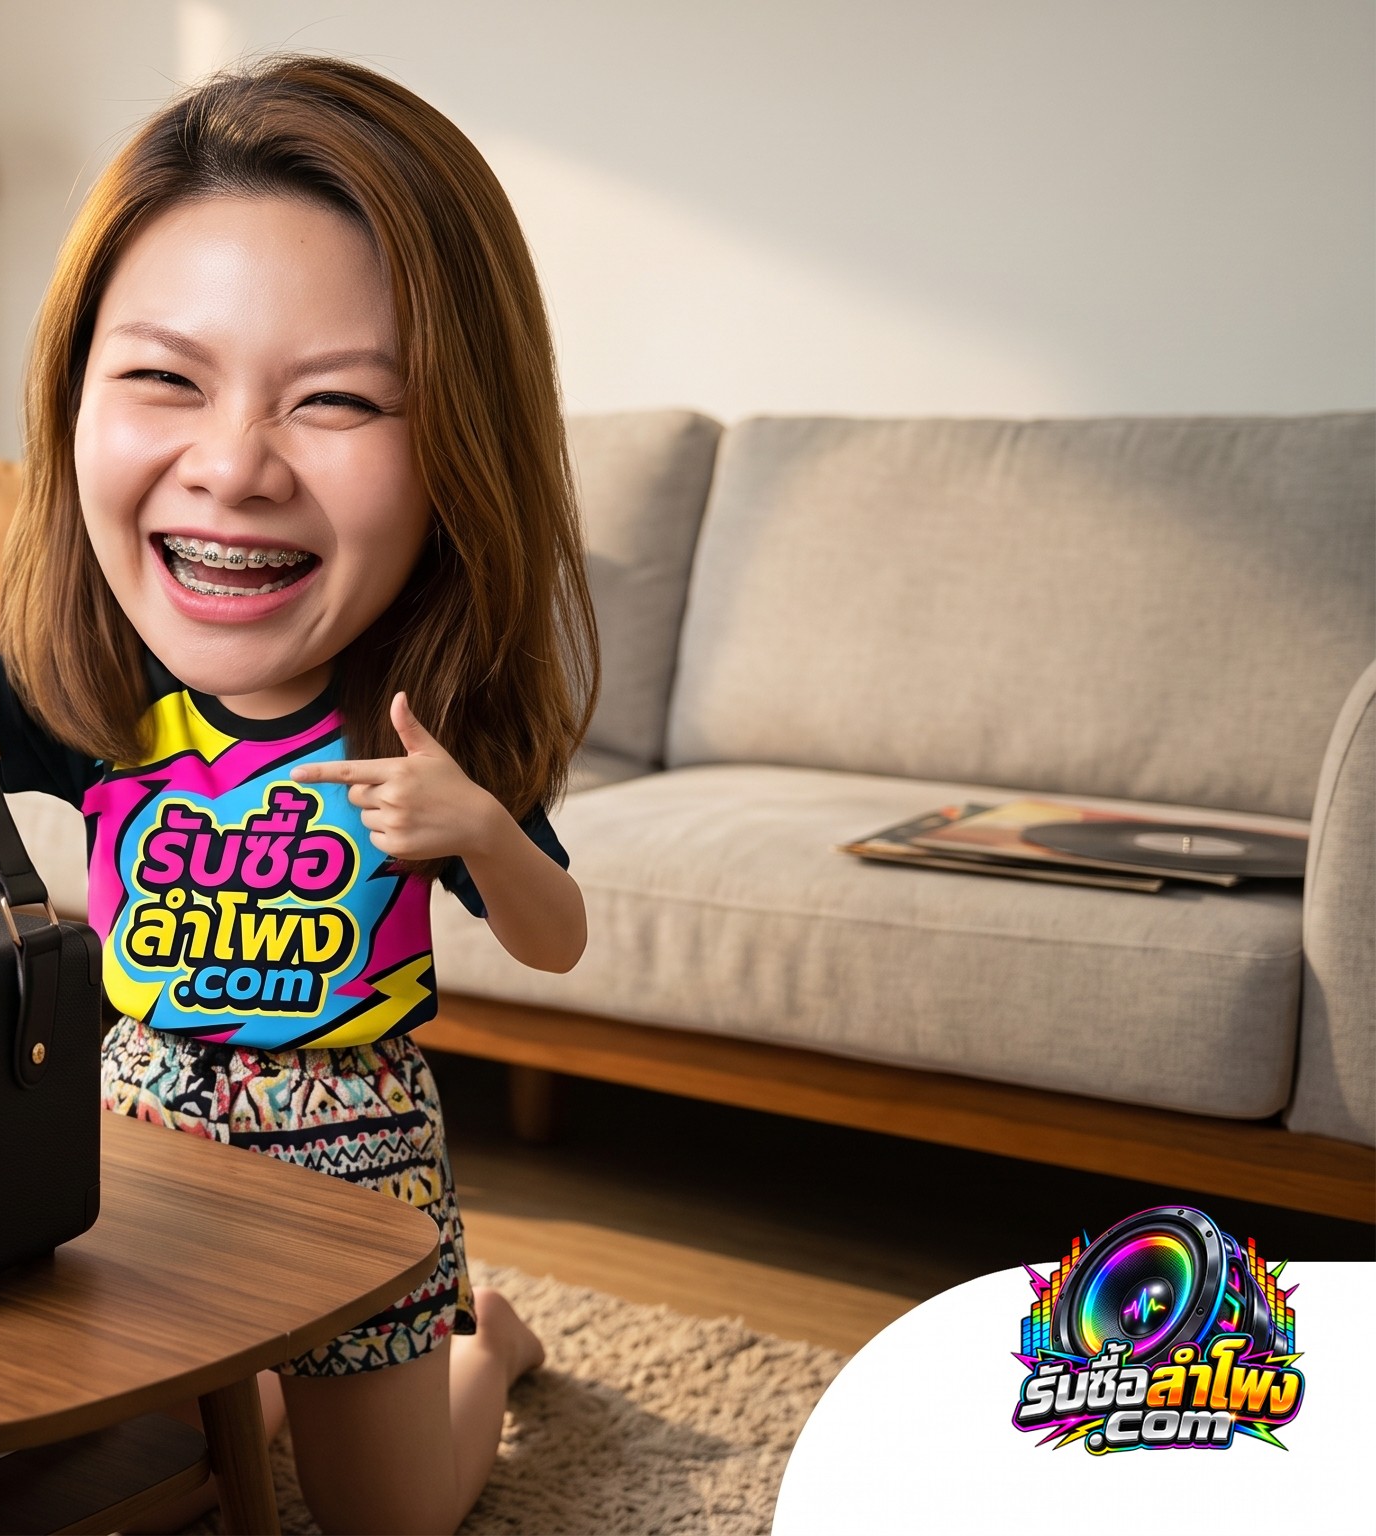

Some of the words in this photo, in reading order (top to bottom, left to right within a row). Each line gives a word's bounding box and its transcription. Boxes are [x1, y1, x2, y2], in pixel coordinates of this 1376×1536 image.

[142, 792, 346, 890] รับซื้อ
[131, 888, 345, 965] ลำโพง
[178, 965, 314, 1003] .com
